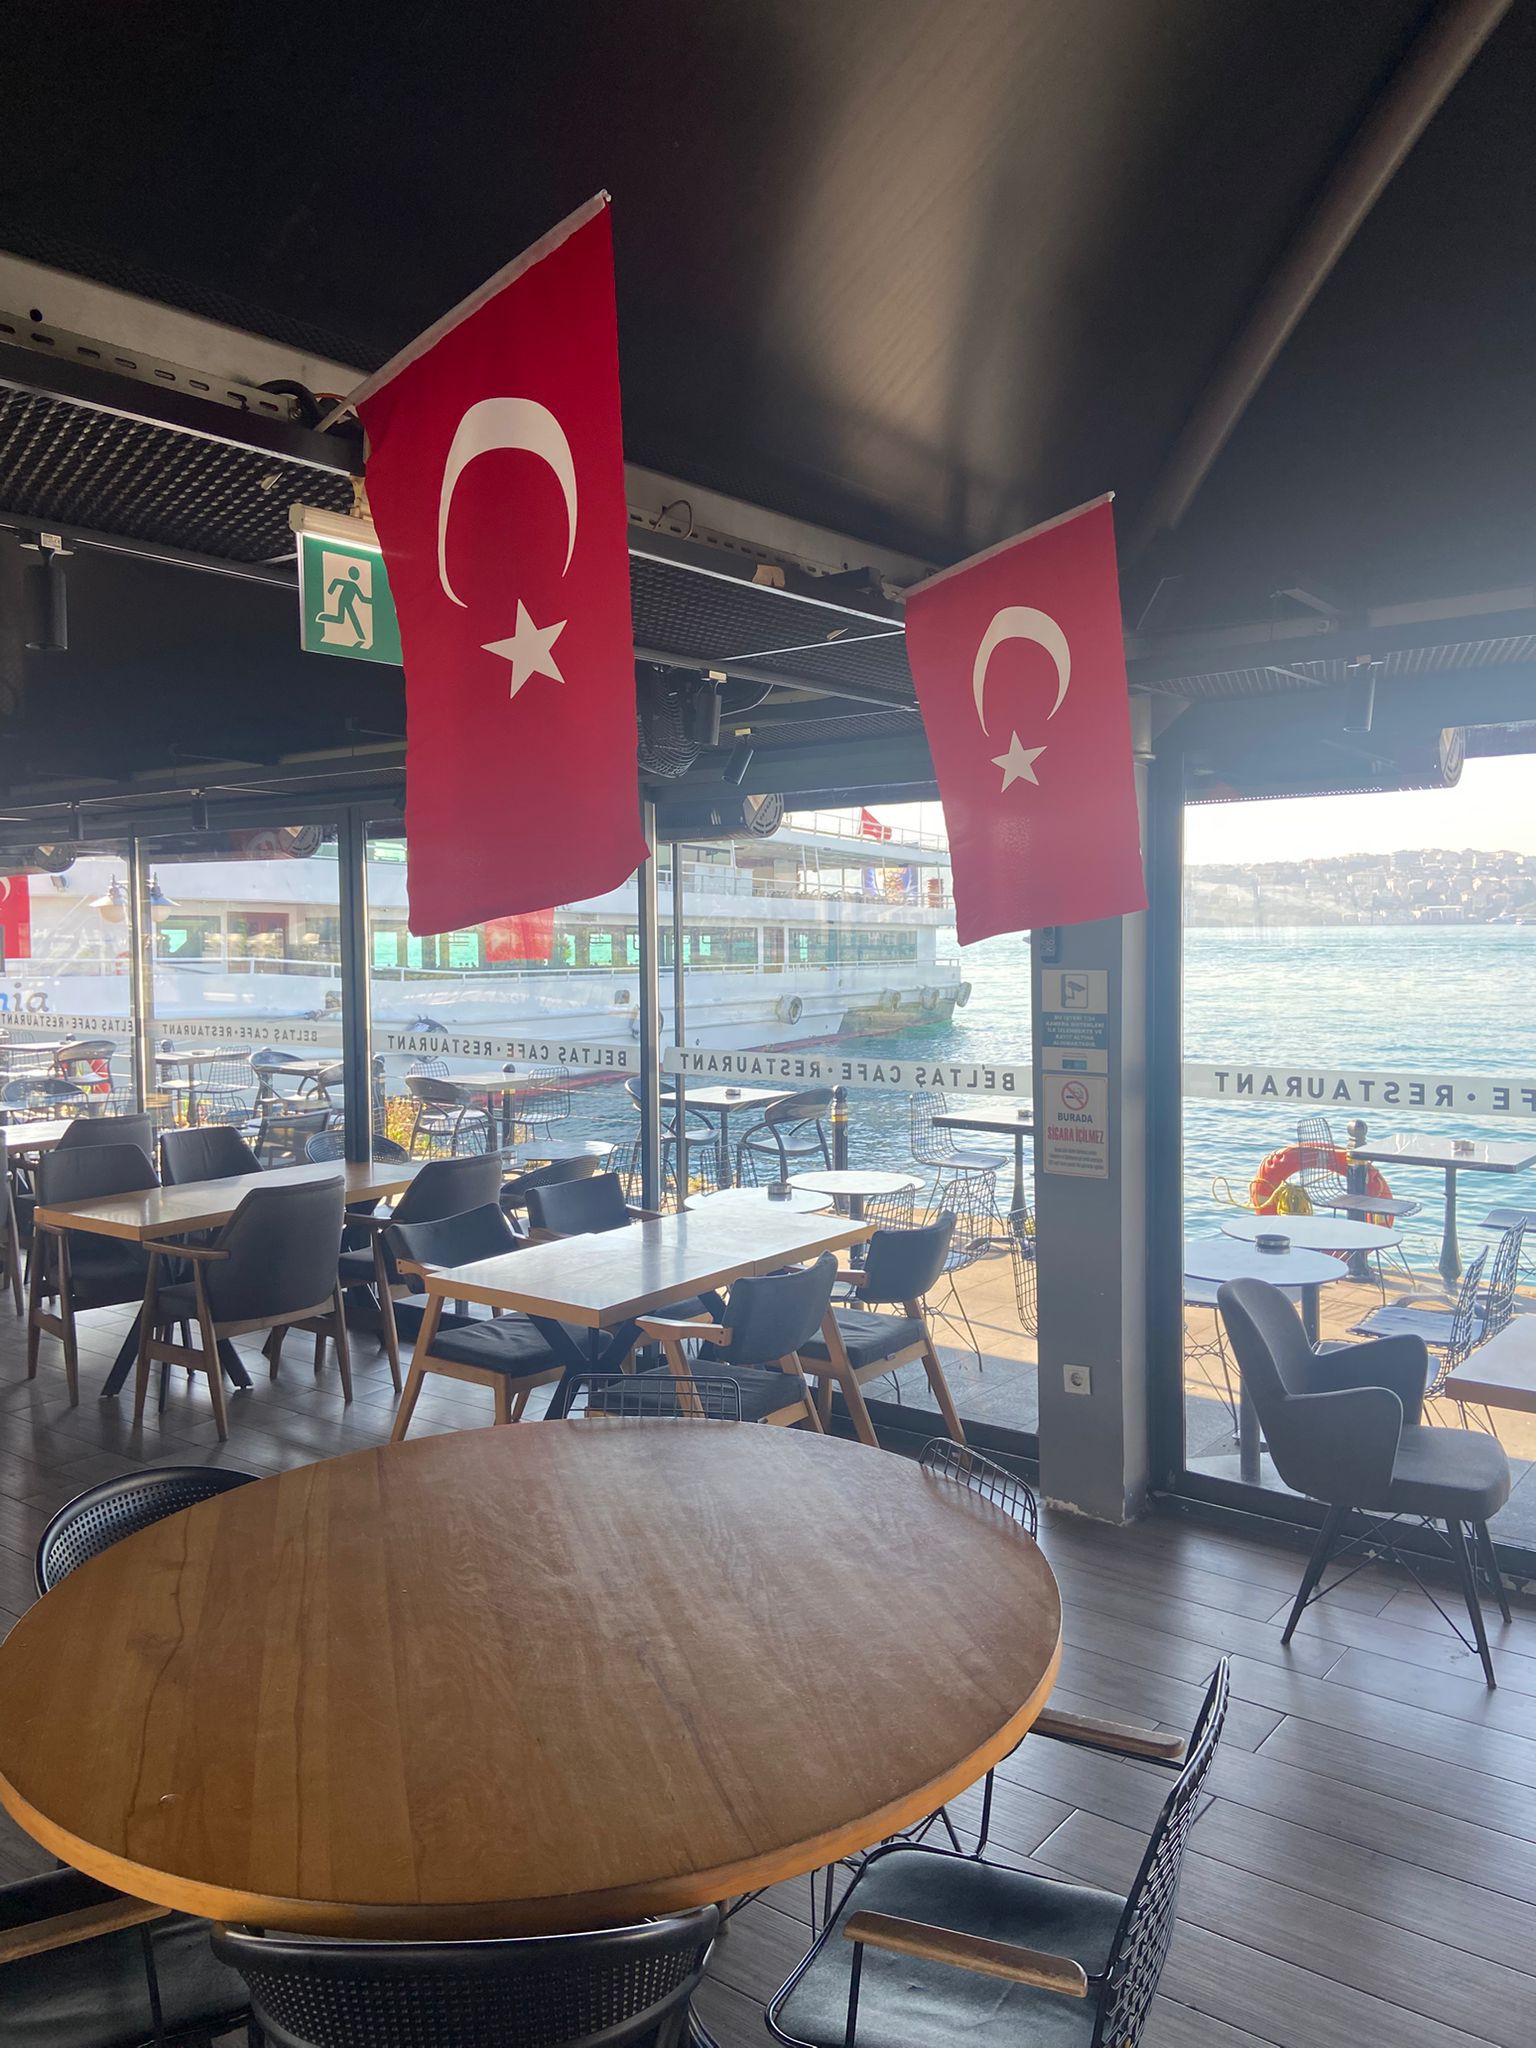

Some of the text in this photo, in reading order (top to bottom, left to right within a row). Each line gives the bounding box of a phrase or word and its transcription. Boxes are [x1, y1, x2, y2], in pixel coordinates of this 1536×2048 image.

[1057, 1112, 1093, 1124] BURADA
[1047, 1125, 1105, 1145] SİGARA İÇİLMEZ
